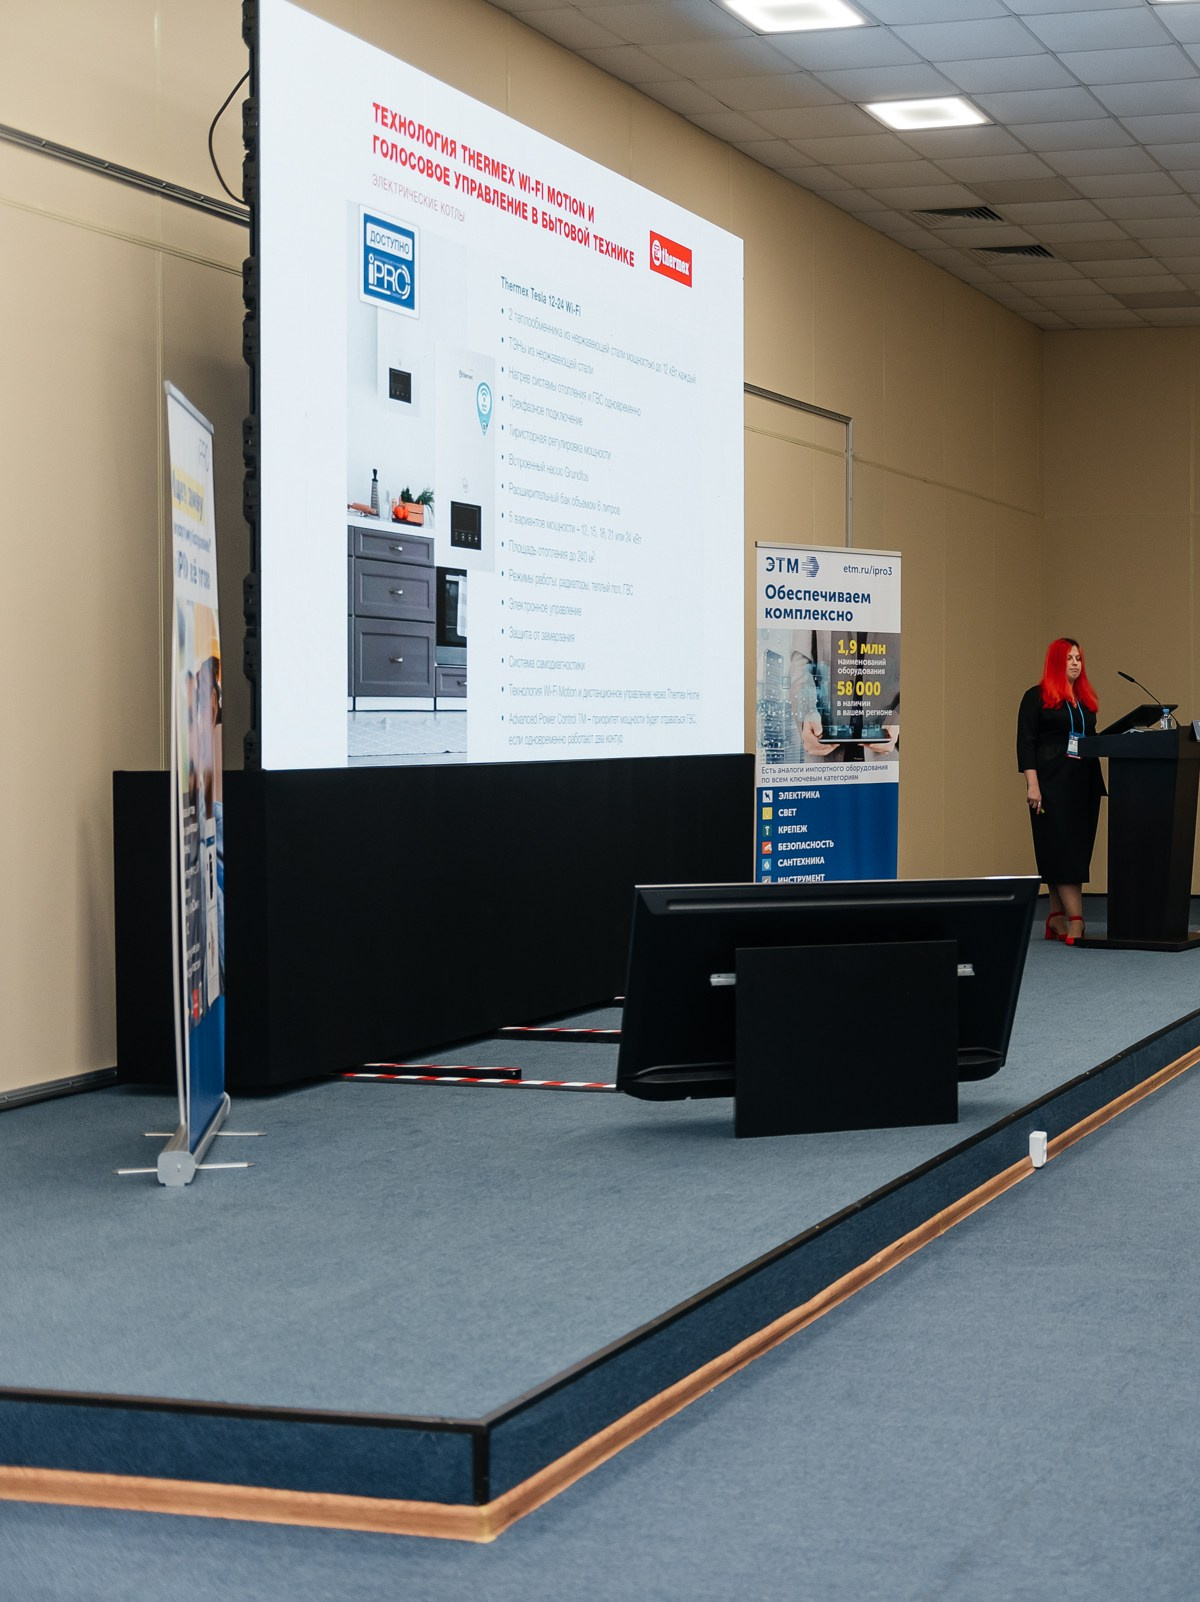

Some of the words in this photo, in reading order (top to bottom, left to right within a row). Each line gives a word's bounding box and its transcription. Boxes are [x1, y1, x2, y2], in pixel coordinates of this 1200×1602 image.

[372, 102, 457, 156] ТЕХНОЛОГИЯ
[461, 145, 514, 186] THERMEX
[518, 174, 544, 201] WI-FI
[548, 186, 586, 214] MOTION
[588, 206, 595, 223] И
[372, 174, 438, 213] ЭЛЕКТРИЧЕСКИЕ
[441, 200, 465, 223] КОТЛЫ
[372, 135, 450, 186] ГОЛОСОВОЕ
[454, 171, 528, 220] УПРАВЛЕНИЕ
[532, 209, 538, 225] В
[541, 213, 590, 248] БЫТОВОЙ
[593, 235, 635, 267] ТЕХНИКЕ
[370, 231, 409, 254] ДОСТУПНО
[662, 248, 690, 276] thermex
[369, 253, 410, 299] iPRO
[500, 276, 528, 297] Thermex
[530, 287, 546, 304] Tesla
[548, 295, 563, 310] 12-24
[565, 301, 581, 316] Wi-Fi
[766, 557, 799, 573] ЭТМ
[844, 565, 892, 577] etm.ru/ipro3
[765, 584, 871, 604] Обеспечиваем
[765, 608, 853, 622] комплексно
[838, 640, 857, 655] 1,9
[860, 644, 886, 654] млн
[838, 658, 886, 666] наименований
[838, 667, 885, 676] оборудования
[558, 685, 577, 697] Motion
[837, 681, 852, 695] 58
[856, 681, 880, 695] 000
[509, 713, 537, 724] Advanced
[539, 713, 556, 724] Power
[557, 713, 576, 727] Control
[846, 765, 888, 773] оборудования
[824, 774, 859, 782] категориям
[779, 791, 820, 800] ЭЛЕКТРИКА
[778, 808, 797, 816] СВЕТ
[778, 825, 808, 834] КРЕПЕЖ
[778, 840, 834, 850] БЕЗОПАСНОСТЬ
[778, 857, 825, 866] САНТЕХНИКА
[778, 874, 825, 883] ИНСТРУМЕНТ
